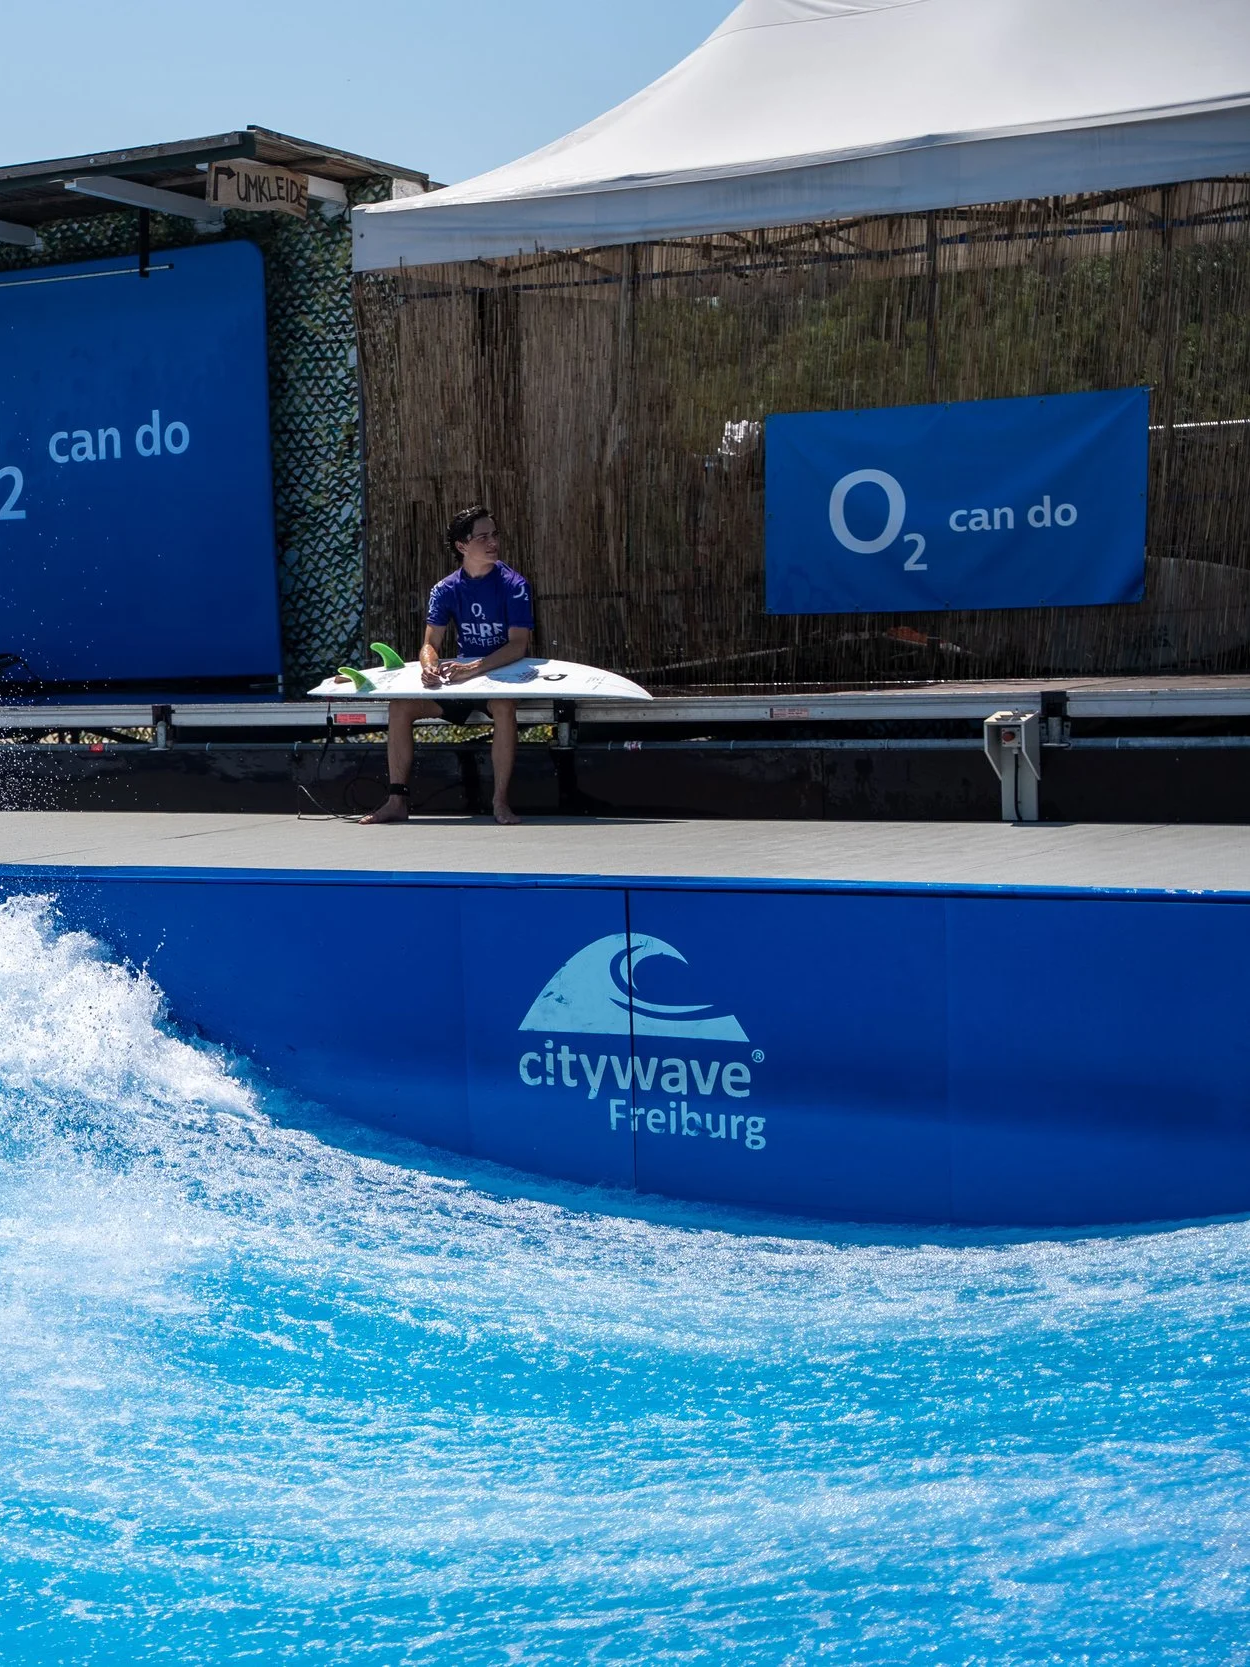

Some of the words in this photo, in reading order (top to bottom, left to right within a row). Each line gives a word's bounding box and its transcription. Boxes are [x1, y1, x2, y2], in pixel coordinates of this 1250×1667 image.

[236, 171, 308, 209] UMKLEIDE
[49, 427, 121, 463] can
[135, 409, 190, 457] do
[829, 468, 928, 571] O2
[949, 505, 1015, 532] can
[1027, 495, 1078, 528] do
[471, 603, 486, 620] O2
[609, 1098, 767, 1150] Freiburg
